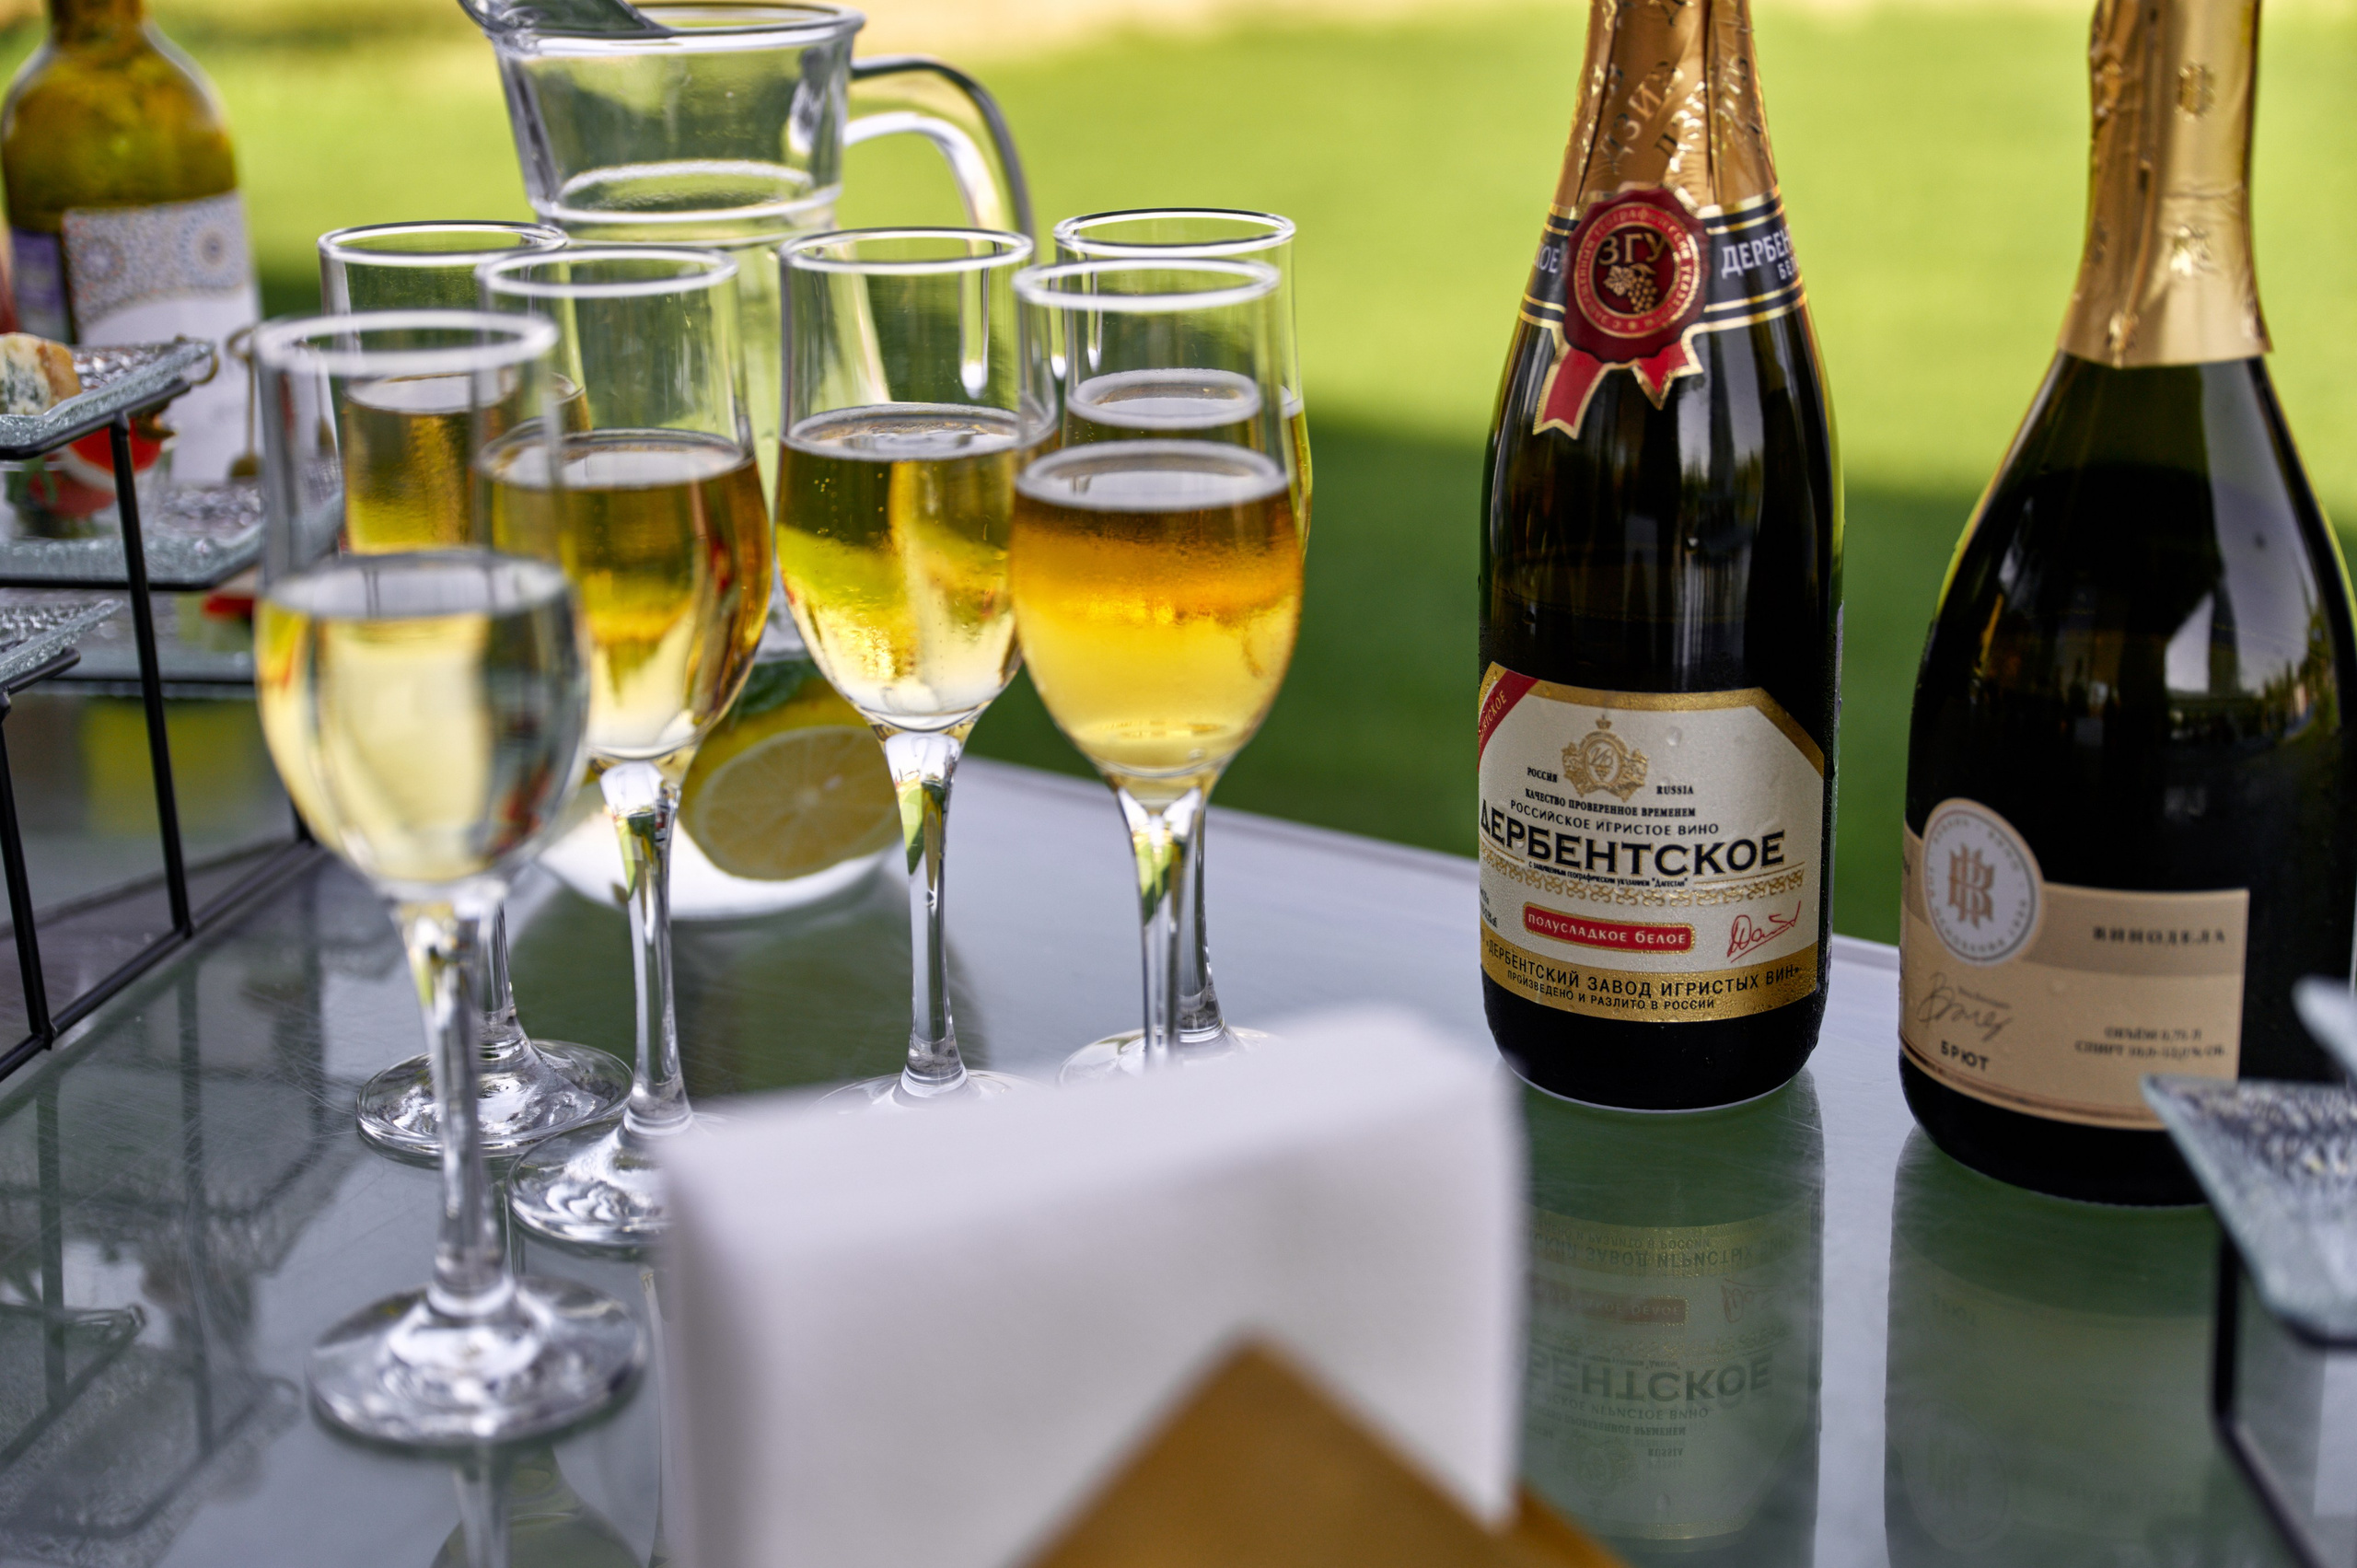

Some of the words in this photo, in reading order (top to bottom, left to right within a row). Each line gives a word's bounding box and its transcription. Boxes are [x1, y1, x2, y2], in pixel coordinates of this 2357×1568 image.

[1598, 232, 1667, 265] ЗГУ
[1527, 766, 1558, 783] РОССИЯ
[1656, 784, 1694, 795] RUSSIA
[1510, 799, 1591, 830] РОССИЙСКОЕ
[1596, 819, 1671, 836] ИГРИСТОЕ
[1678, 823, 1719, 836] ВИНО
[1525, 787, 1566, 807] КАЧЕСТВО
[1568, 799, 1638, 817] ПРОВЕРЕННОЕ
[1642, 807, 1696, 818] ВРЕМЕНЕМ
[1480, 798, 1784, 877] ДЕРБЕНТСКОЕ
[1507, 970, 1573, 1001] ПРОИЗВЕДЕНО
[1578, 993, 1585, 1003] И
[1590, 994, 1646, 1010] РАЗЛИТО
[1651, 1001, 1658, 1010] В
[1587, 976, 1652, 999] ЗАВОД
[1661, 974, 1759, 997] ИГРИСТЫХ
[1940, 1039, 1991, 1073] БРЮТ
